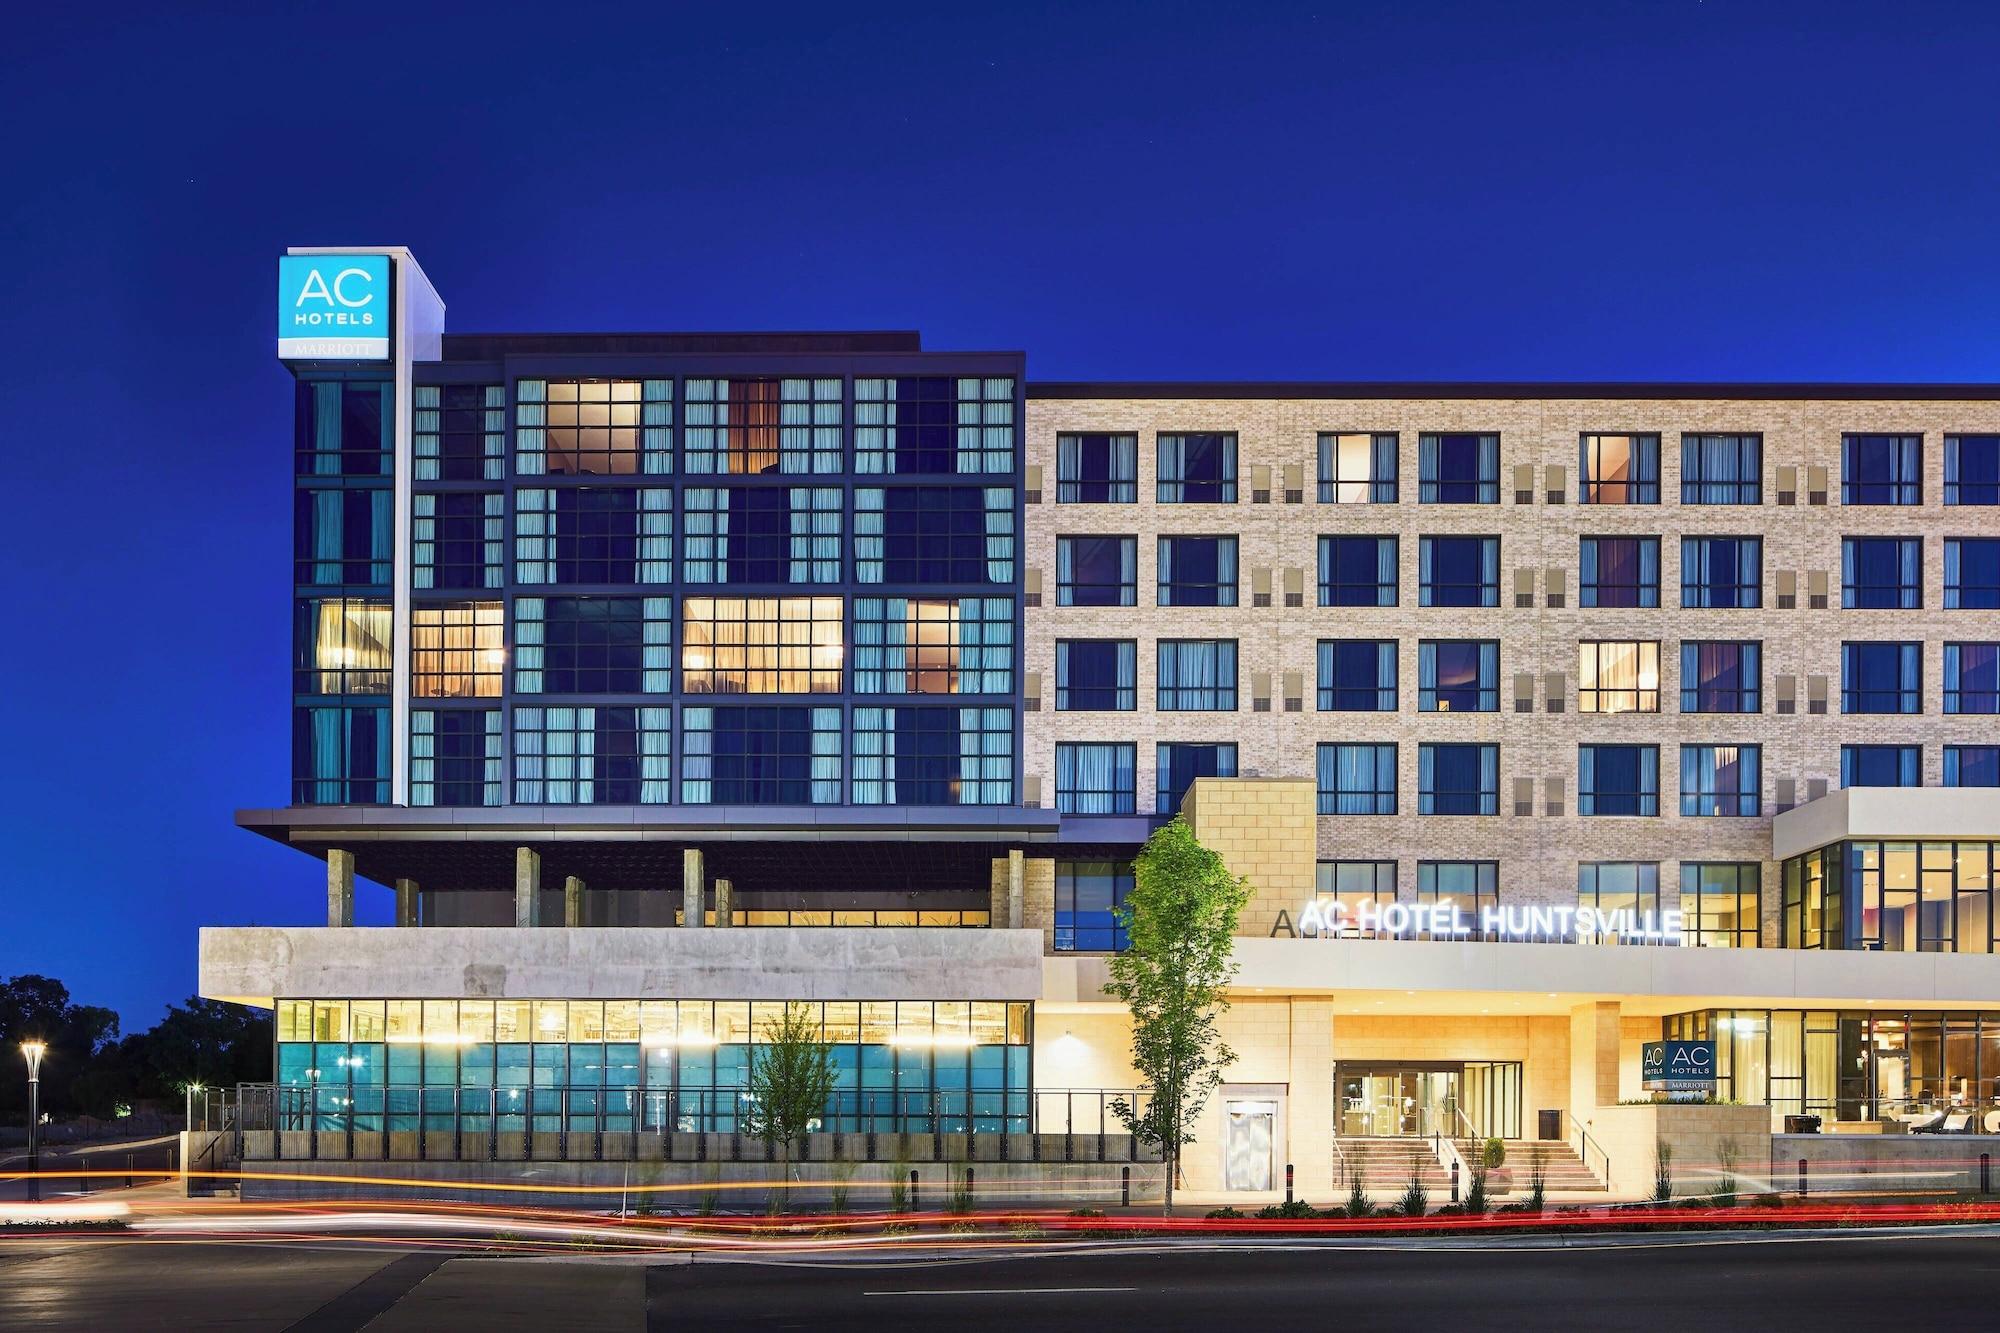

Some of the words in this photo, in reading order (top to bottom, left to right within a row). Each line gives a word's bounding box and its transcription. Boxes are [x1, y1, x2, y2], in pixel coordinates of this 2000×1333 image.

[296, 268, 373, 308] AC
[295, 313, 373, 325] HOTELS
[296, 343, 369, 355] MARRIOTT
[1300, 900, 1349, 931] AC
[1483, 905, 1681, 938] HUNTSVILLE
[1645, 1047, 1663, 1066] AC
[1672, 1047, 1710, 1065] AC
